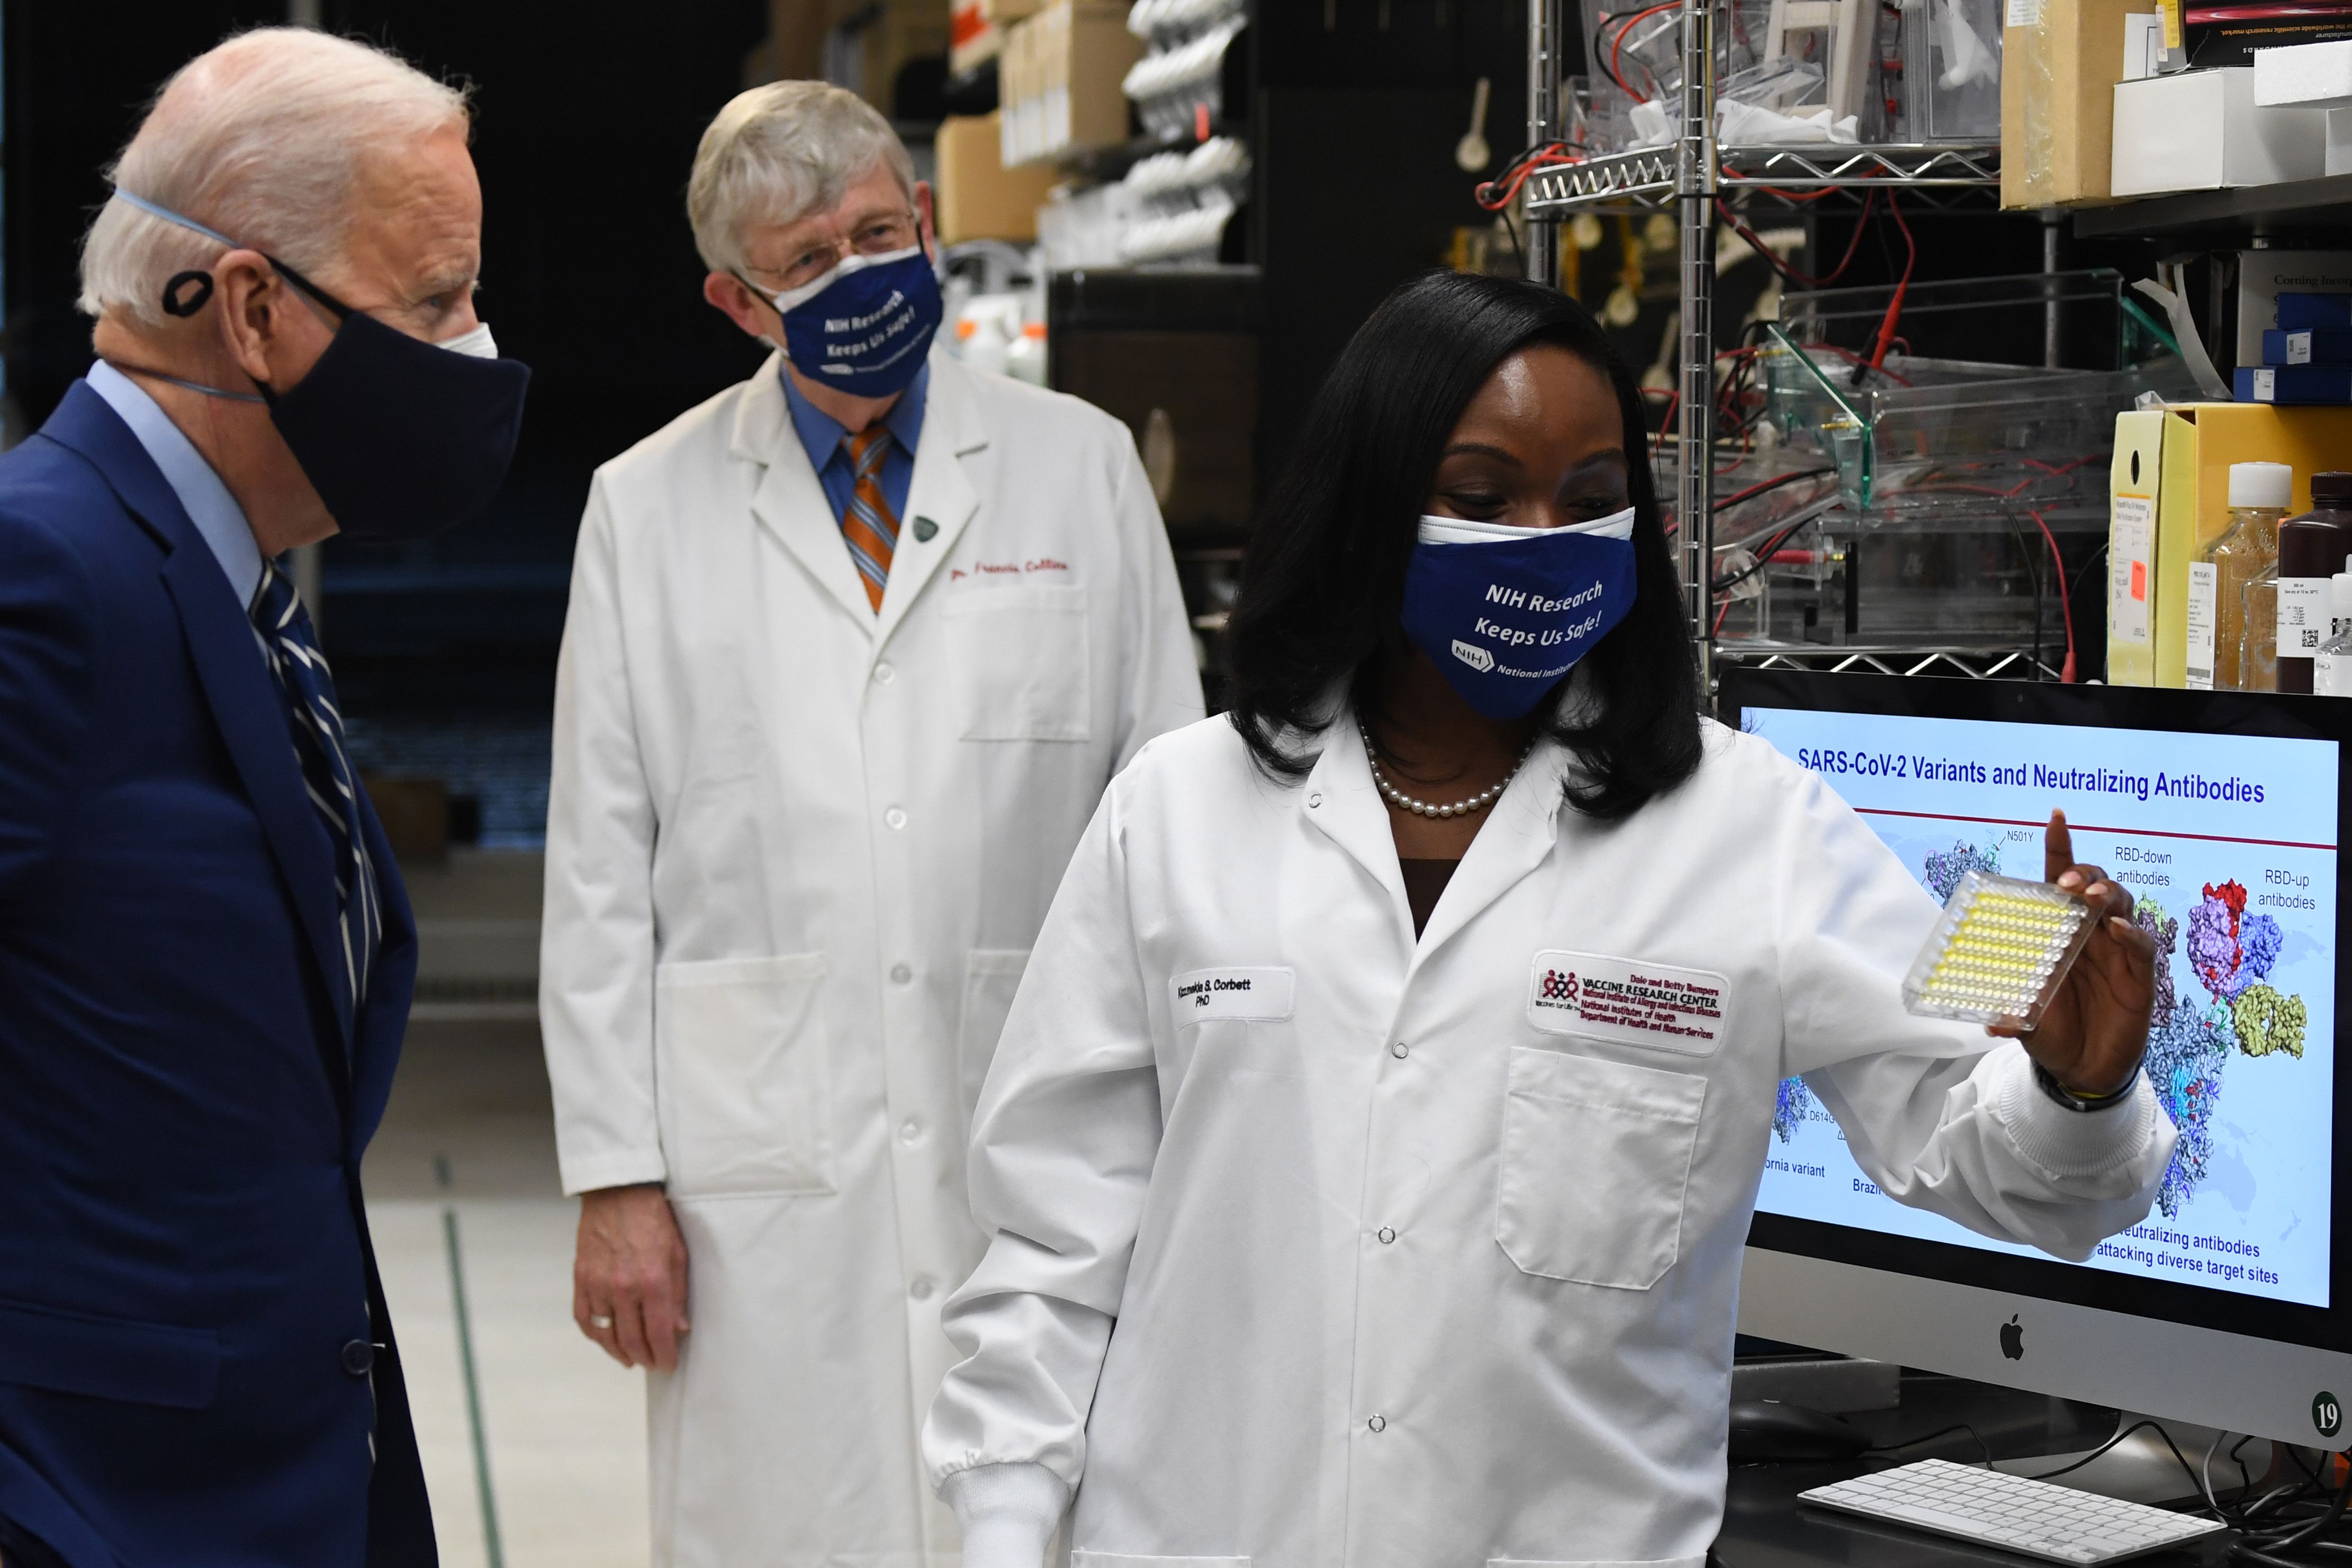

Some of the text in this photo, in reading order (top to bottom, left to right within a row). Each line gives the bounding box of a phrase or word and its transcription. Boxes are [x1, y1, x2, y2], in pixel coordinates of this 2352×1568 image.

[2275, 274, 2318, 286] Corning
[1485, 580, 1602, 612] NIH Research
[1474, 610, 1602, 646] Keeps Us Safe!
[1455, 646, 1483, 665] NIH
[1497, 664, 1543, 678] National
[1798, 748, 2265, 803] SARS-CoV-2 Variants and Neutralizing Antibodies
[2007, 830, 2033, 842] N501Y
[2115, 846, 2171, 865] RBD-down
[2116, 869, 2170, 886] antibodies
[2266, 869, 2309, 890] RBD-up
[2258, 893, 2315, 910] antibodies
[1214, 979, 1251, 990] Corbett
[1582, 978, 1717, 1008] VACCINE RESEARCH CENTER
[1583, 988, 1606, 999] National
[1630, 974, 1647, 984] Dale
[1664, 980, 1685, 992] Betty
[1687, 983, 1719, 996] Bumpers
[1195, 995, 1210, 1007] PhD
[1581, 999, 1676, 1022] National Institutes of Health
[1580, 1010, 1617, 1024] Department
[1627, 1017, 1647, 1029] Health
[1649, 1023, 1662, 1031] and
[1810, 1111, 1835, 1123] D614G
[1792, 1163, 1825, 1178] variant
[2119, 1224, 2260, 1258] eutralizing antibodies
[2097, 1242, 2278, 1285] attacking diverse target sites
[2318, 1403, 2338, 1429] 19
